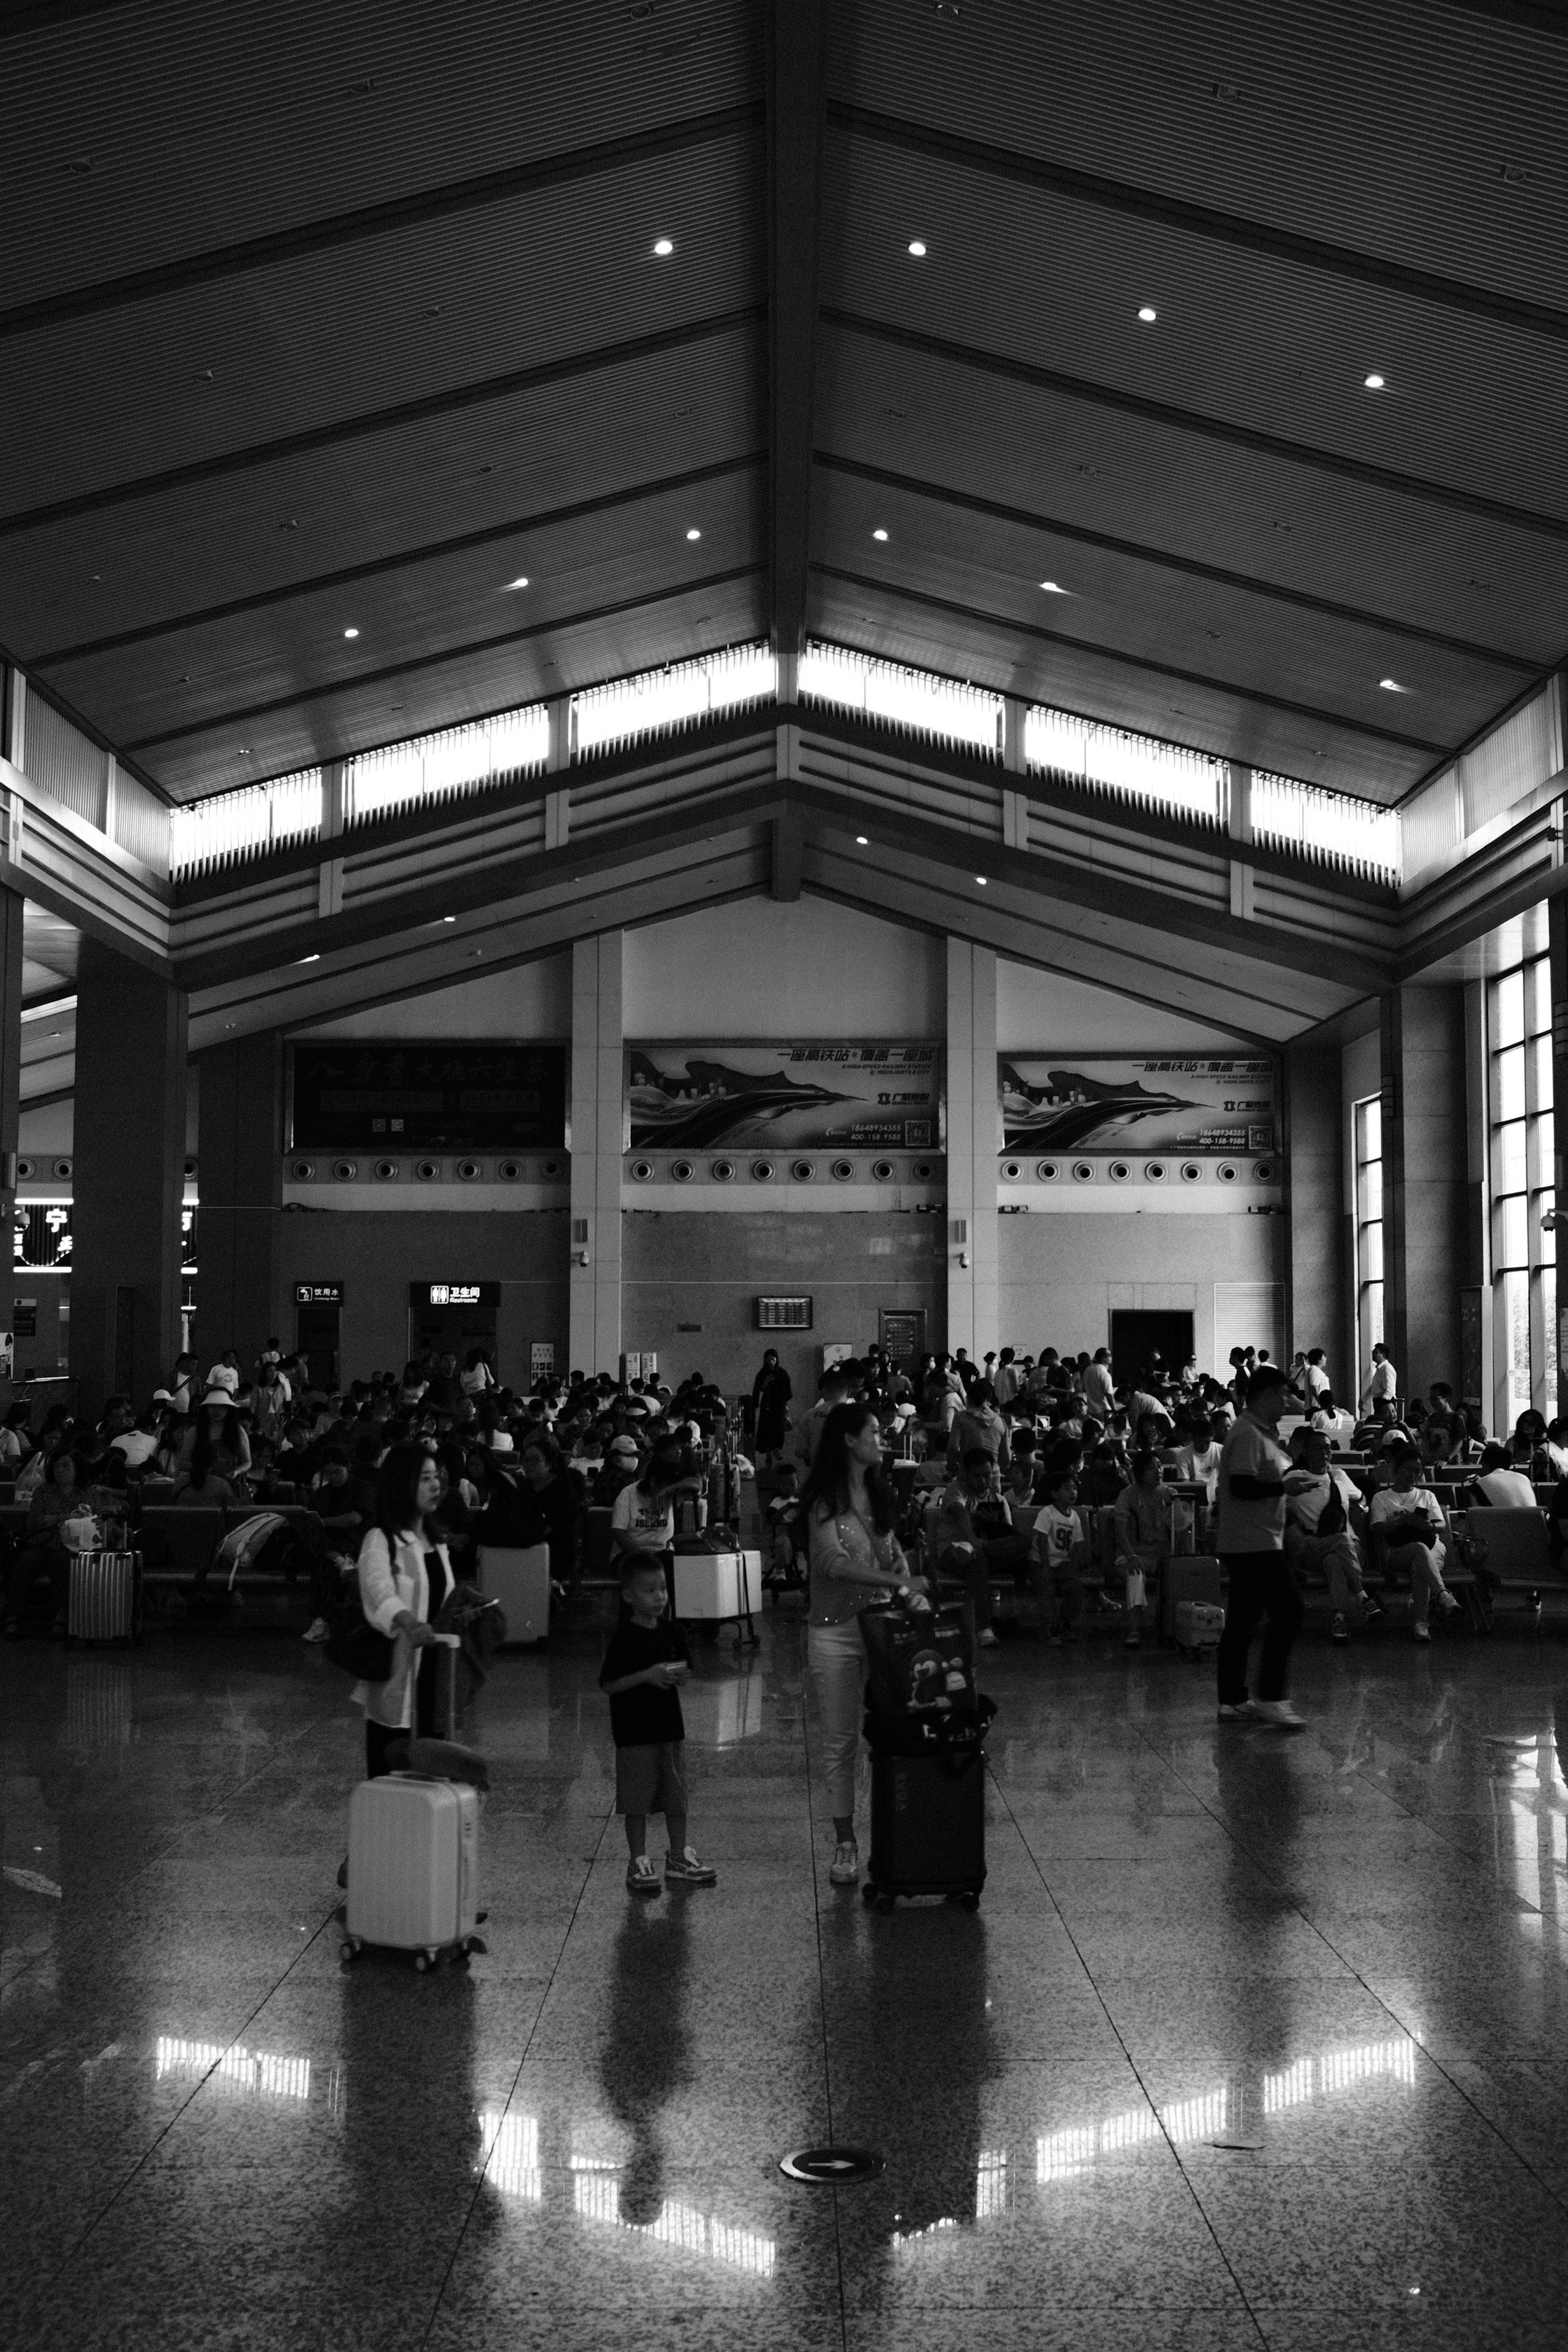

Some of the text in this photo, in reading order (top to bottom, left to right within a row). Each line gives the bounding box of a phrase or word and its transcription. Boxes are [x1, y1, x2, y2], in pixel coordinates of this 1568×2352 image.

[777, 1049, 933, 1061] 一座高铁站 覆盖一座城
[1133, 1061, 1199, 1072] 一座高铁站
[450, 1287, 480, 1297] 卫生间
